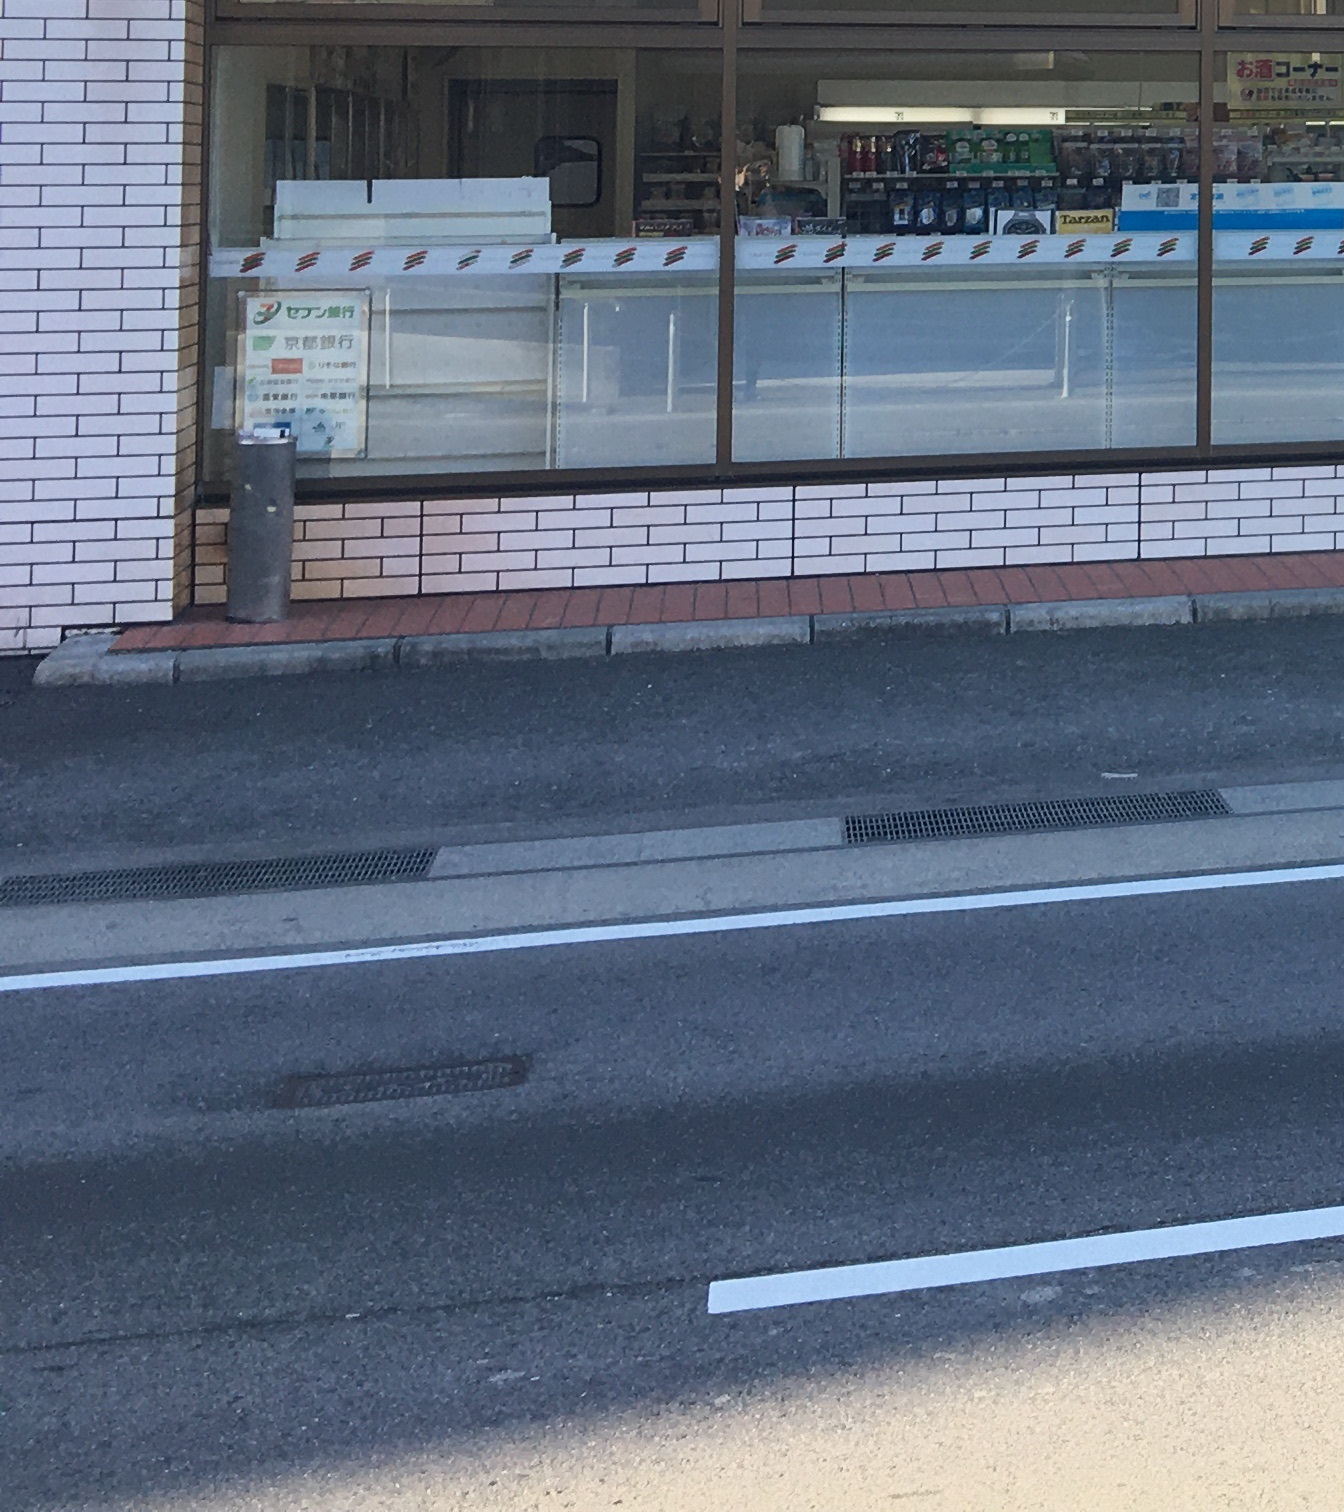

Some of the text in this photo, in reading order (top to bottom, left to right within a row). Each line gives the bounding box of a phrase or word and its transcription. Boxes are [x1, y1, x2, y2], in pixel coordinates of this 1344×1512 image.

[1236, 58, 1339, 80] お酒コーナー
[1060, 214, 1111, 225] Tarzan
[286, 305, 355, 320] セブン銀行
[284, 334, 354, 350] 京都銀行
